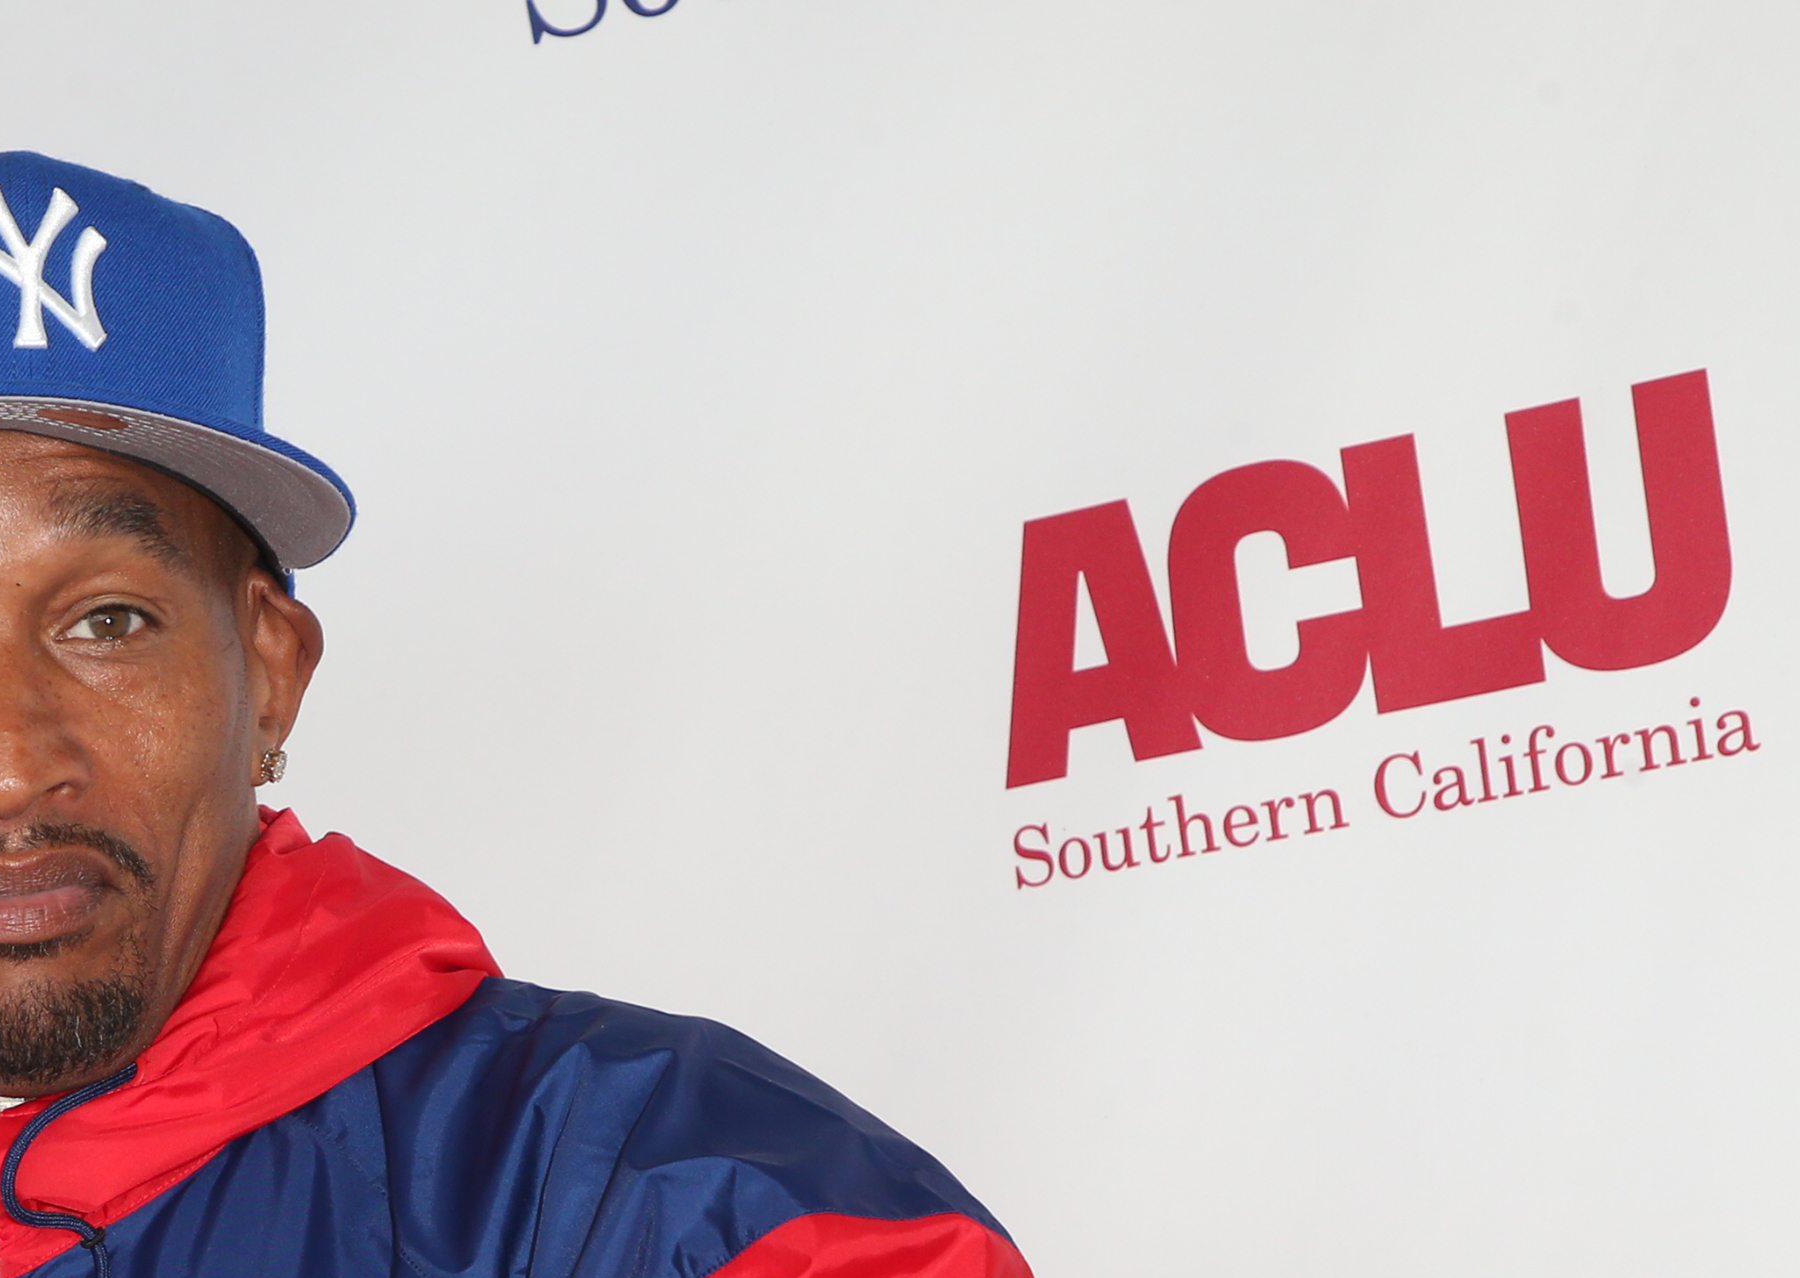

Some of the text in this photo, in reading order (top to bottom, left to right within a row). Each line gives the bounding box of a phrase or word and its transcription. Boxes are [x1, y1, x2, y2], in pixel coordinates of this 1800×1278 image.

[1006, 368, 1733, 790] ACLU
[1012, 696, 1761, 891] Southern California
